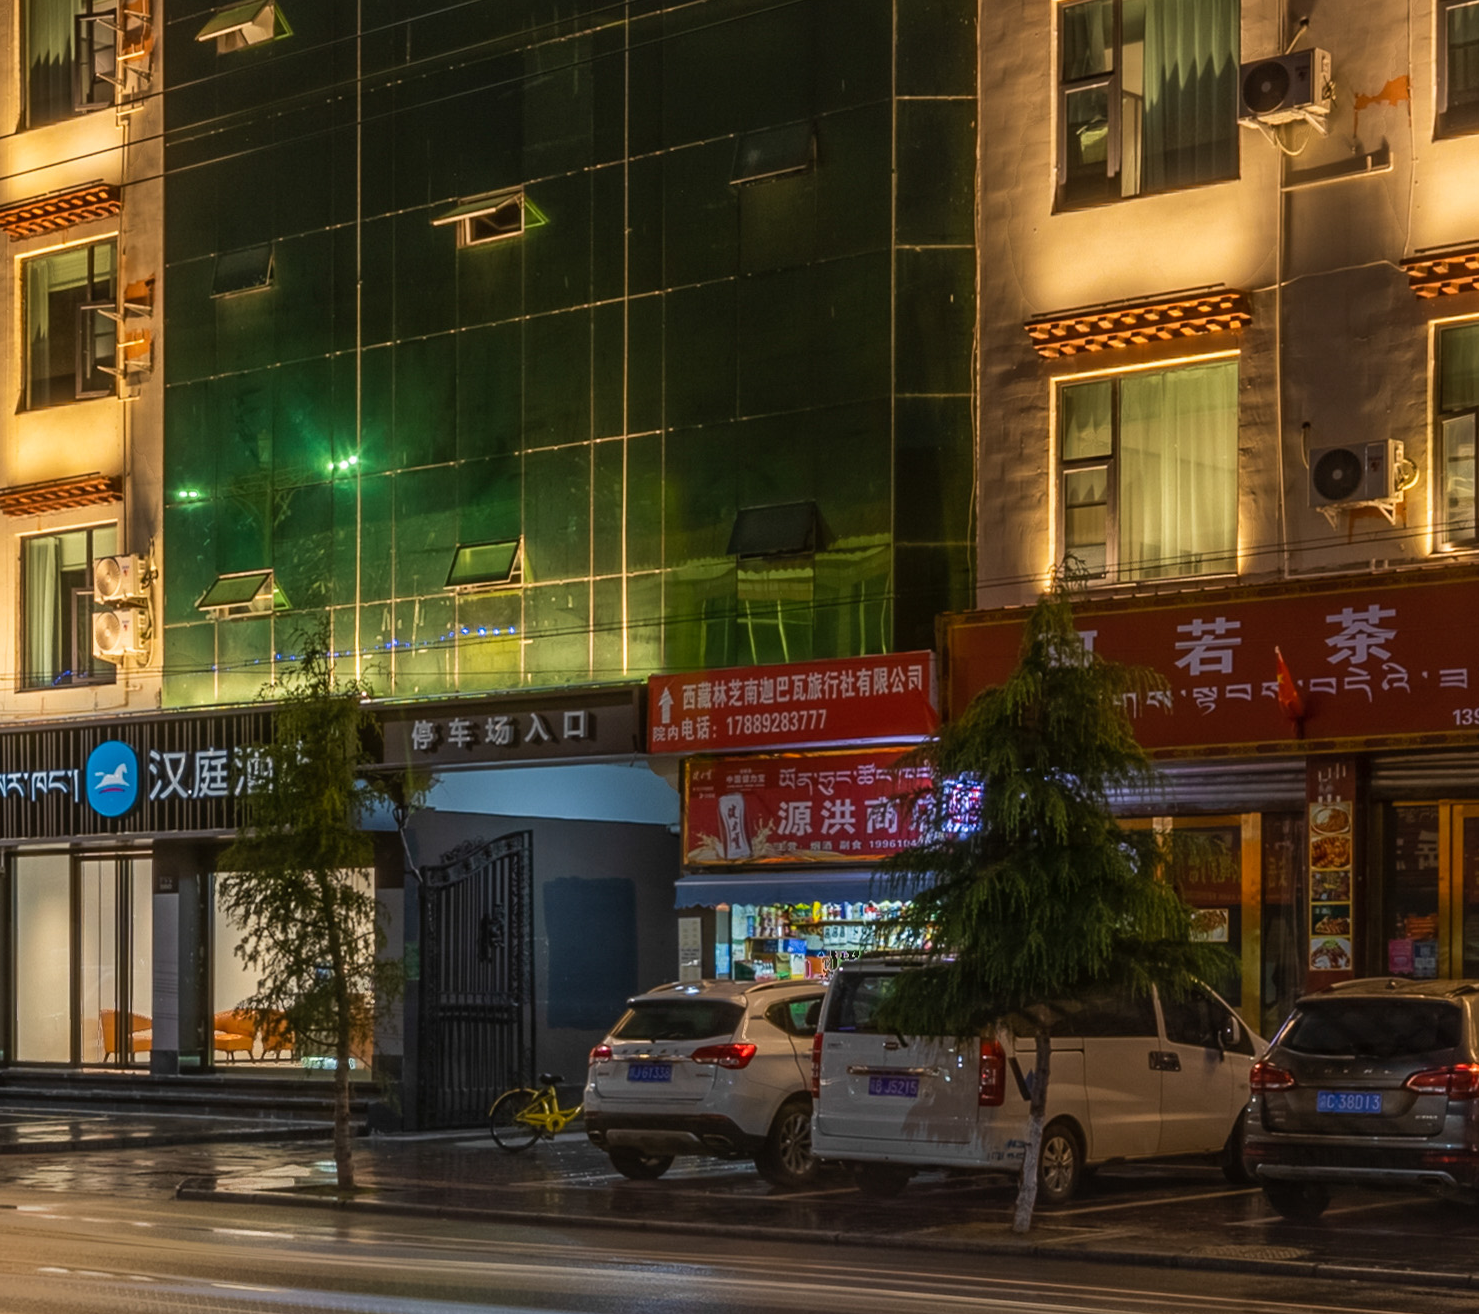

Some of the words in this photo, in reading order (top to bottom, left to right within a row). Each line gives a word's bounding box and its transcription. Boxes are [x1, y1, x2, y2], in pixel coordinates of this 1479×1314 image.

[410, 709, 586, 751] 停车场入口
[652, 725, 679, 743] 院内
[726, 709, 827, 737] 17889283777
